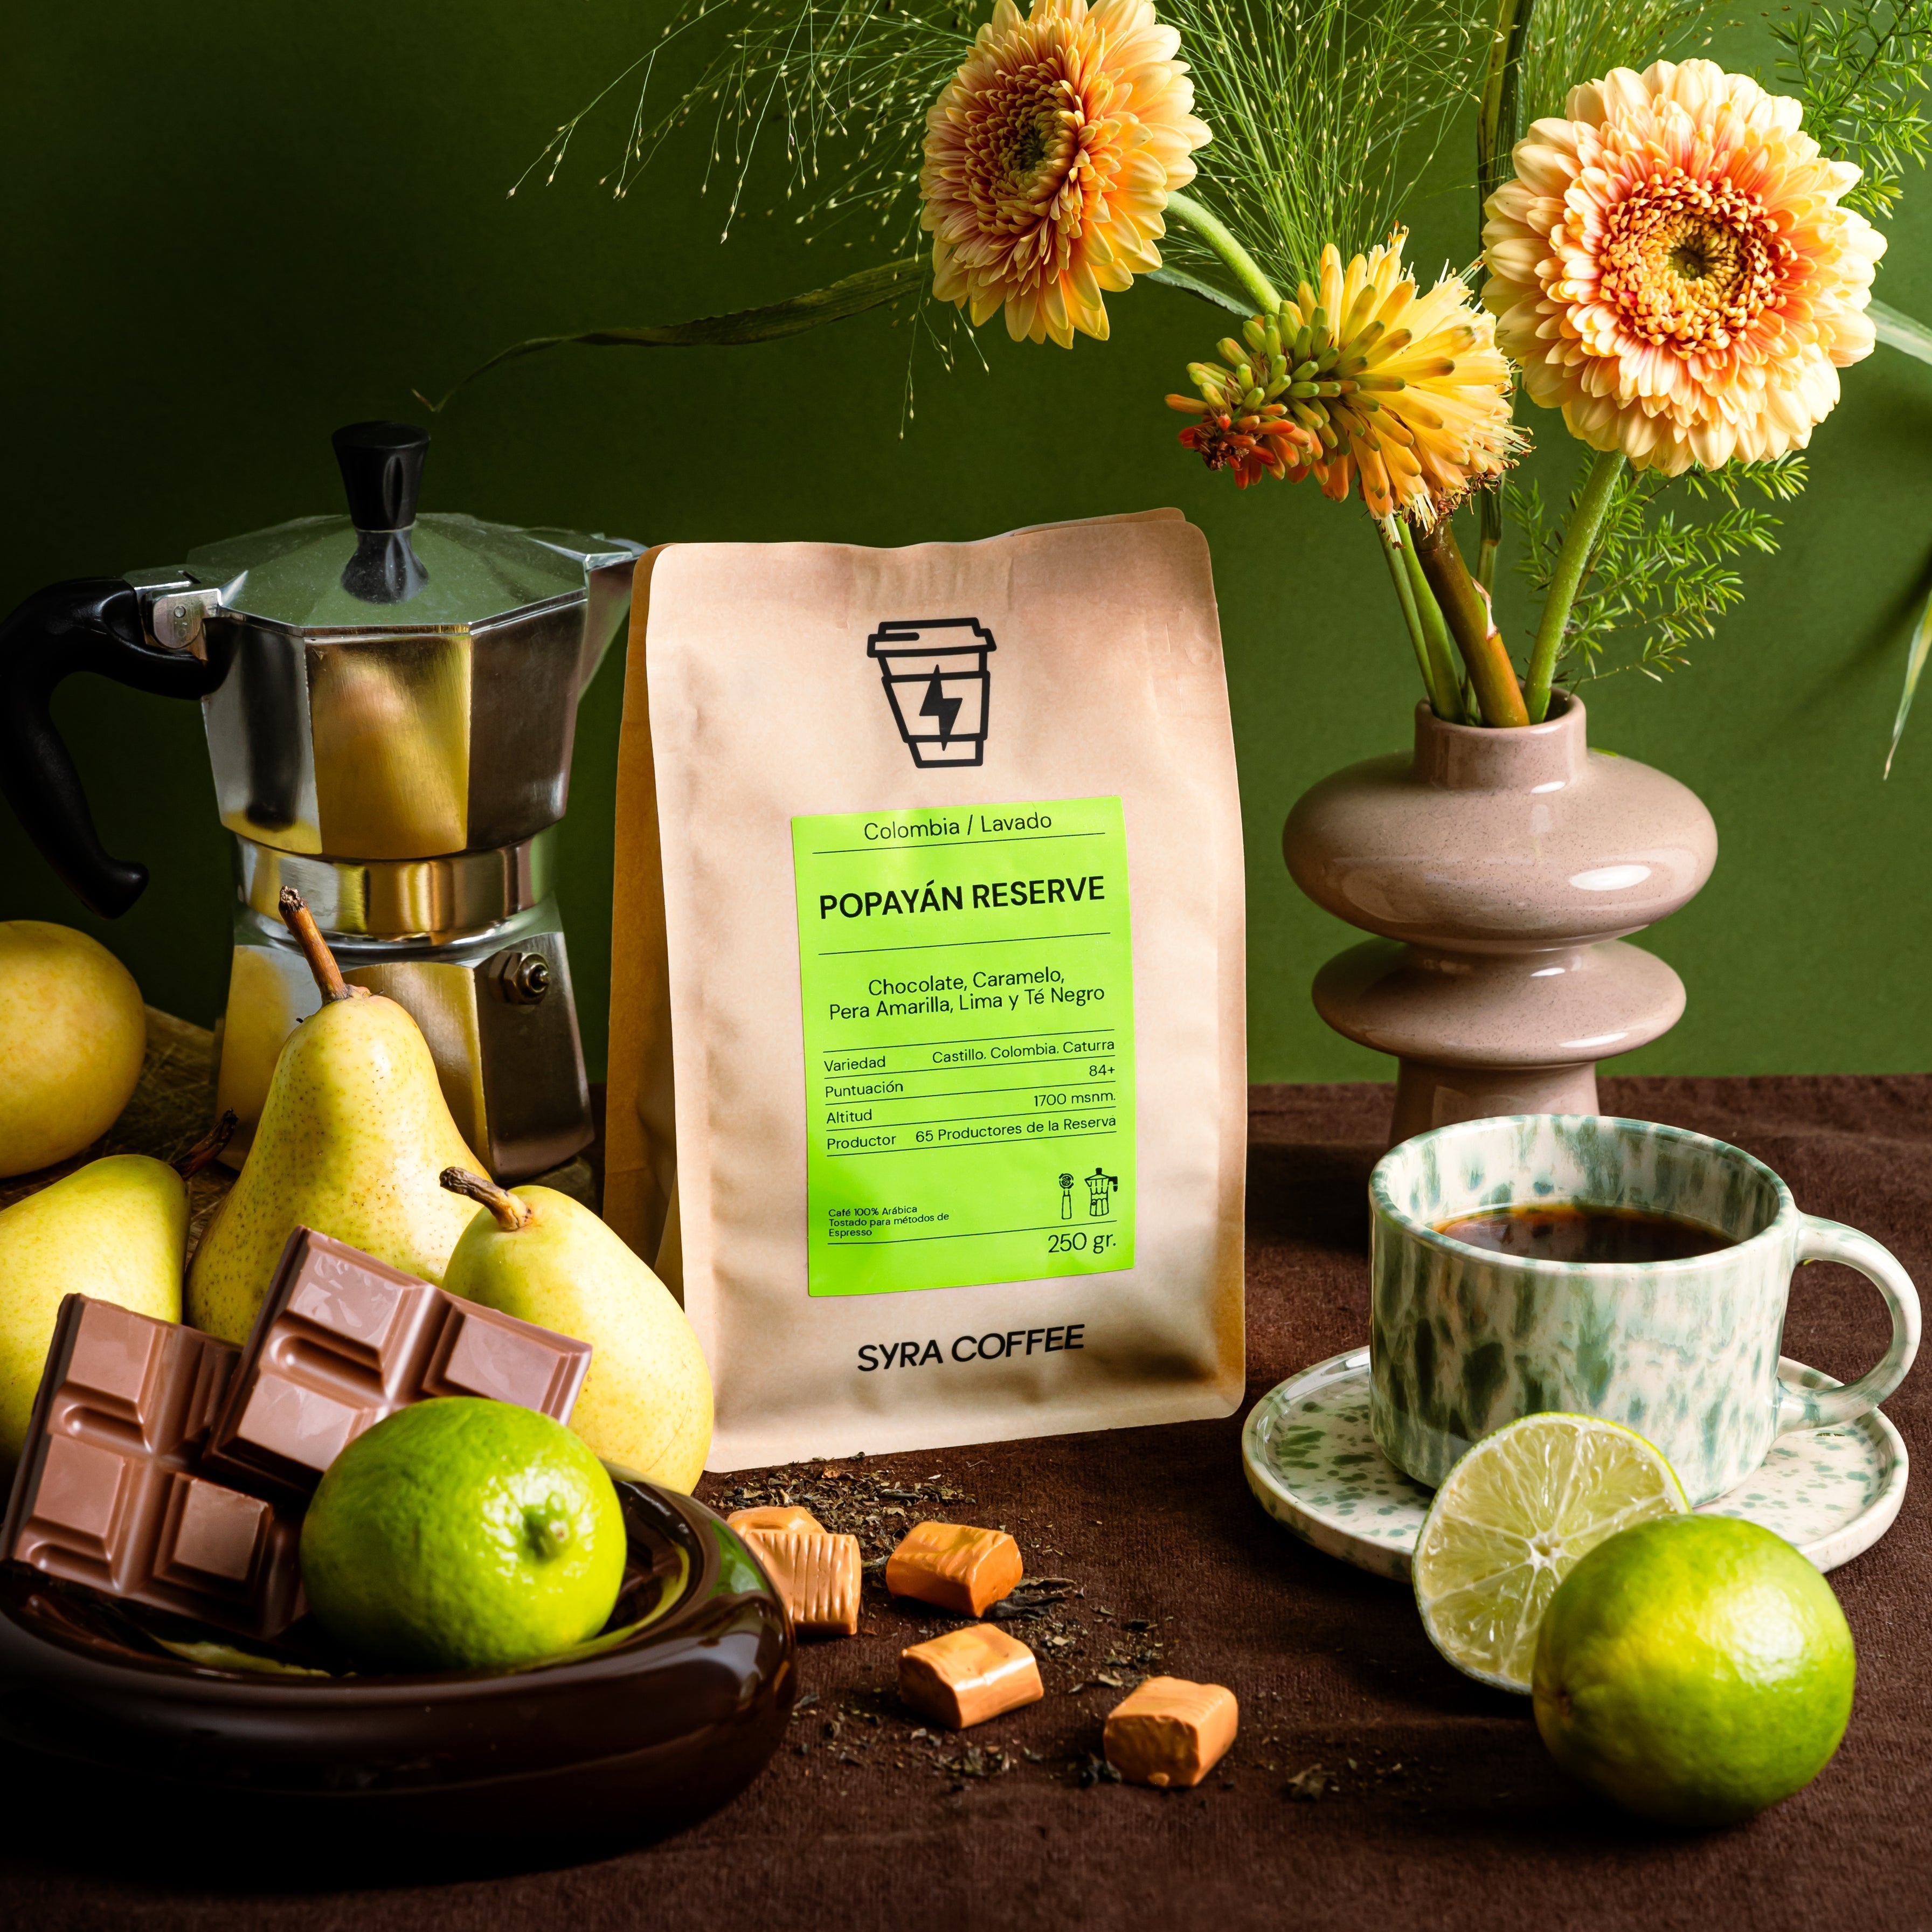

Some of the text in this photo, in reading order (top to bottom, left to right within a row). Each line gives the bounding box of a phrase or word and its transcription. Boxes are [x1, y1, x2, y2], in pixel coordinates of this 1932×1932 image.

[864, 811, 1052, 840] Colombia / Lavado
[820, 875, 1105, 919] POPAYÁN RESERVE
[868, 966, 1064, 996] Chocolate, Caramelo,
[829, 986, 1105, 1020] Pera Amarilla, Lima y Té Negro
[1063, 1041, 1114, 1053] Caturra
[823, 1055, 886, 1072] Variedad
[1089, 1064, 1116, 1077] 84+
[825, 1080, 904, 1098] Puntuación
[1034, 1092, 1116, 1107] 1700 msnm.
[826, 1108, 872, 1124] Altitud
[916, 1117, 1116, 1142] 65 Productores de la Reserva
[827, 1135, 897, 1150] Productor
[828, 1206, 917, 1217] Café 100% Arábica
[828, 1213, 950, 1228] Tostado para métodos de
[829, 1228, 872, 1239] Espresso
[1048, 1232, 1116, 1254] 250 gr.
[857, 1324, 1085, 1372] SYRA COFFEE
